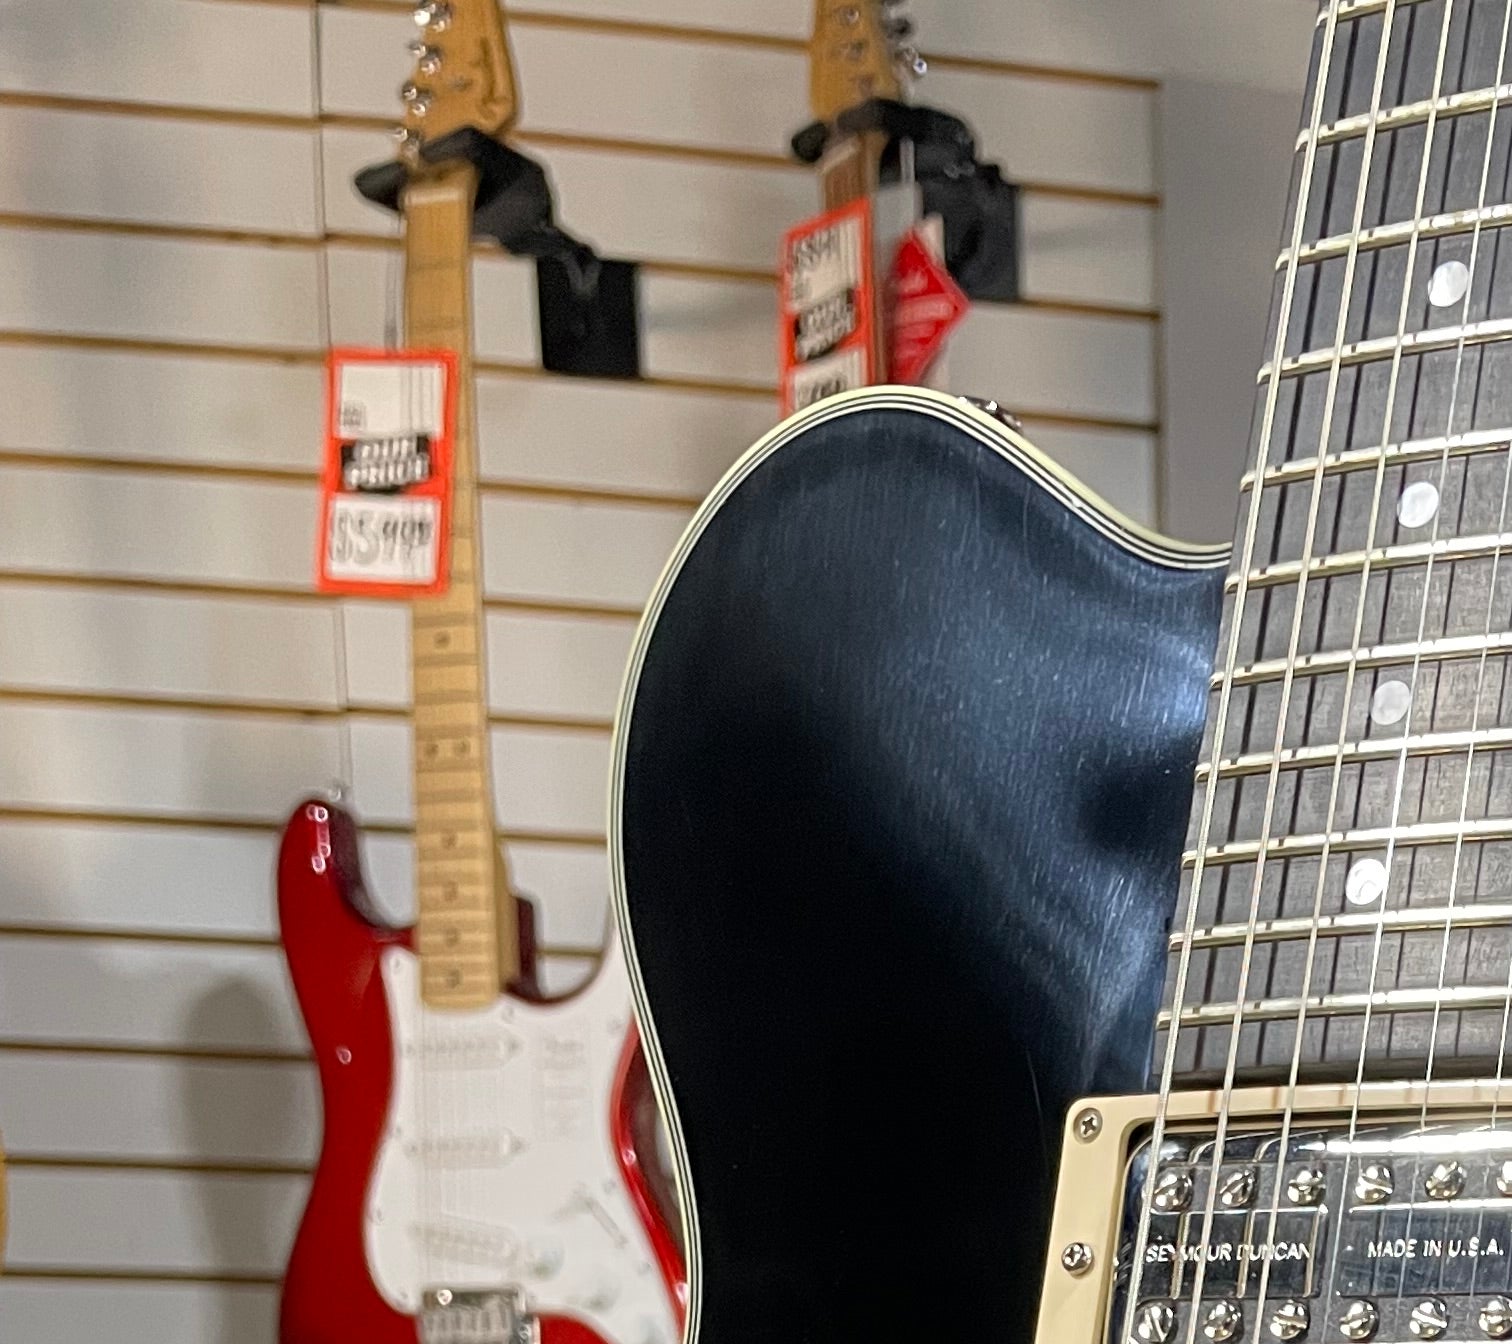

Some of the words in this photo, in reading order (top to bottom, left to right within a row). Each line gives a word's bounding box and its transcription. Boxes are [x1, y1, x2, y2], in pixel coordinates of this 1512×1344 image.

[1367, 1238, 1418, 1259] MADE
[1423, 1239, 1442, 1258] IN
[1448, 1236, 1505, 1258] U.S.A.
